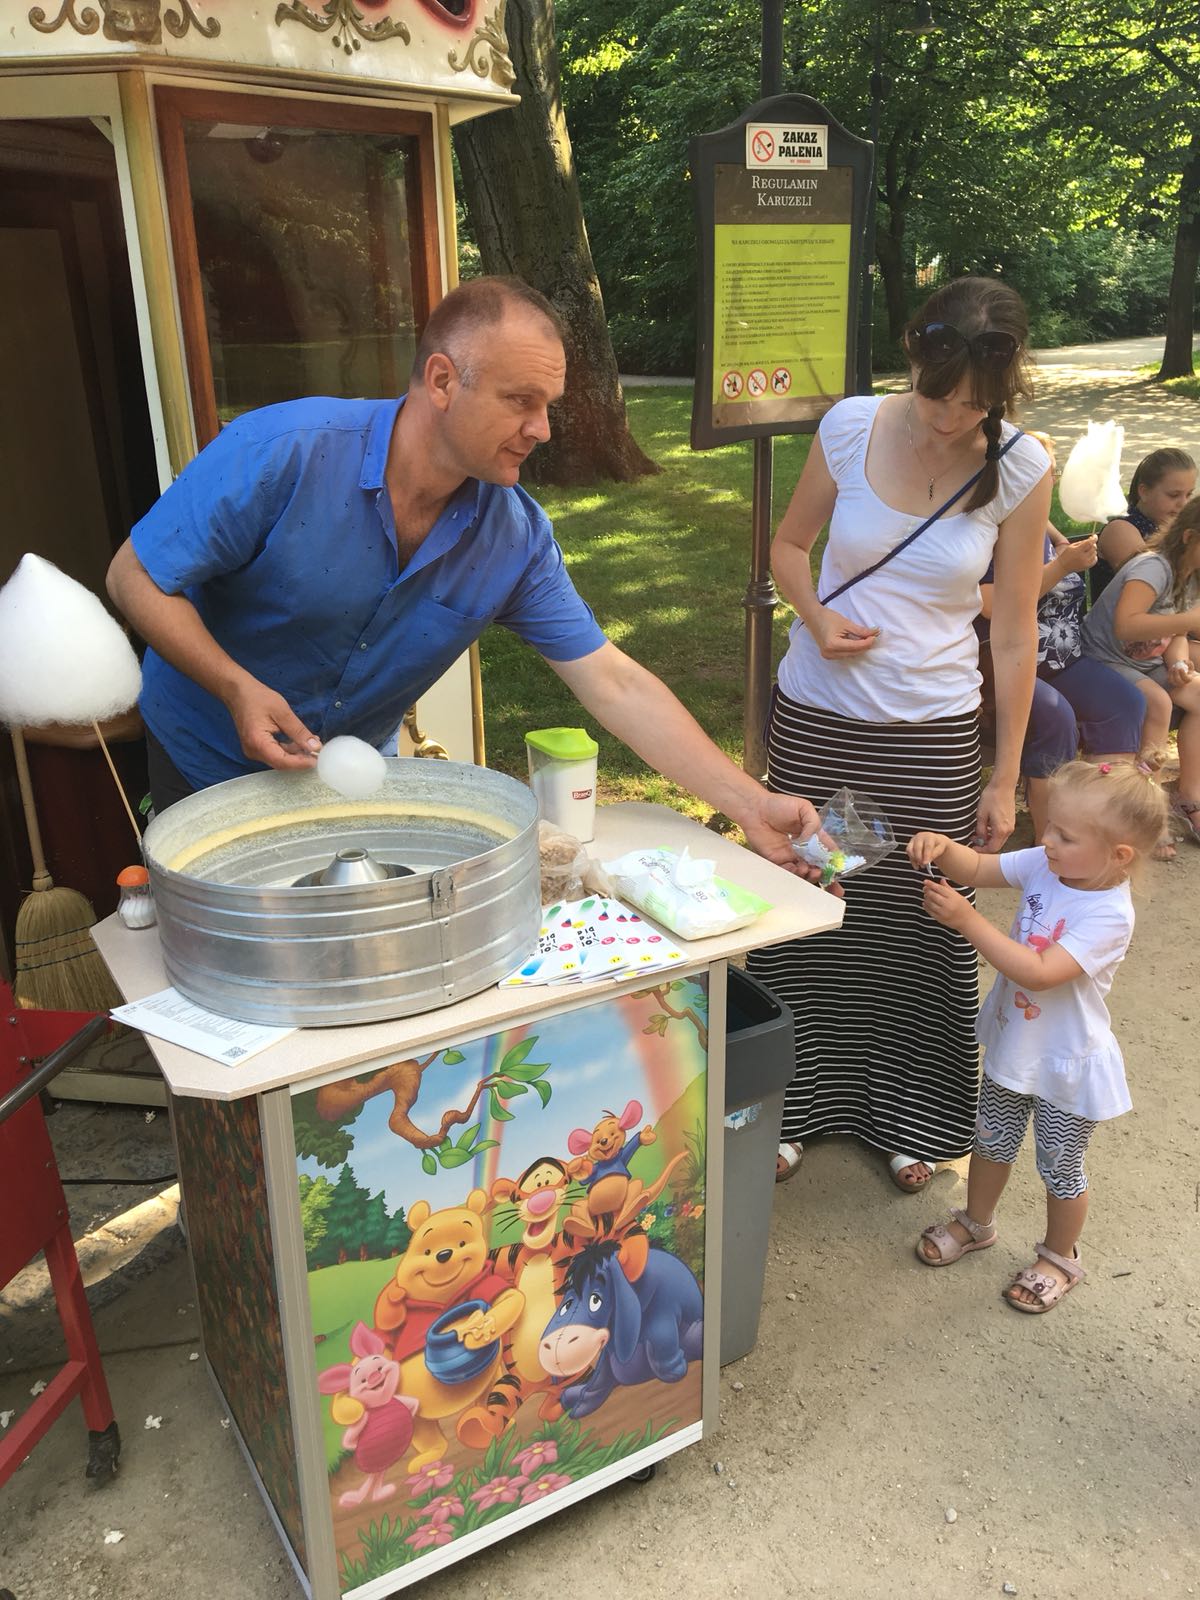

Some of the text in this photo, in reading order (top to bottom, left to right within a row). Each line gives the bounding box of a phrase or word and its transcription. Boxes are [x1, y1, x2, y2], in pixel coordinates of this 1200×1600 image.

[783, 131, 818, 143] ZAKAZ
[778, 146, 823, 158] PALENIA
[751, 175, 818, 190] REGULAMIN
[757, 192, 812, 207] KARUZELI
